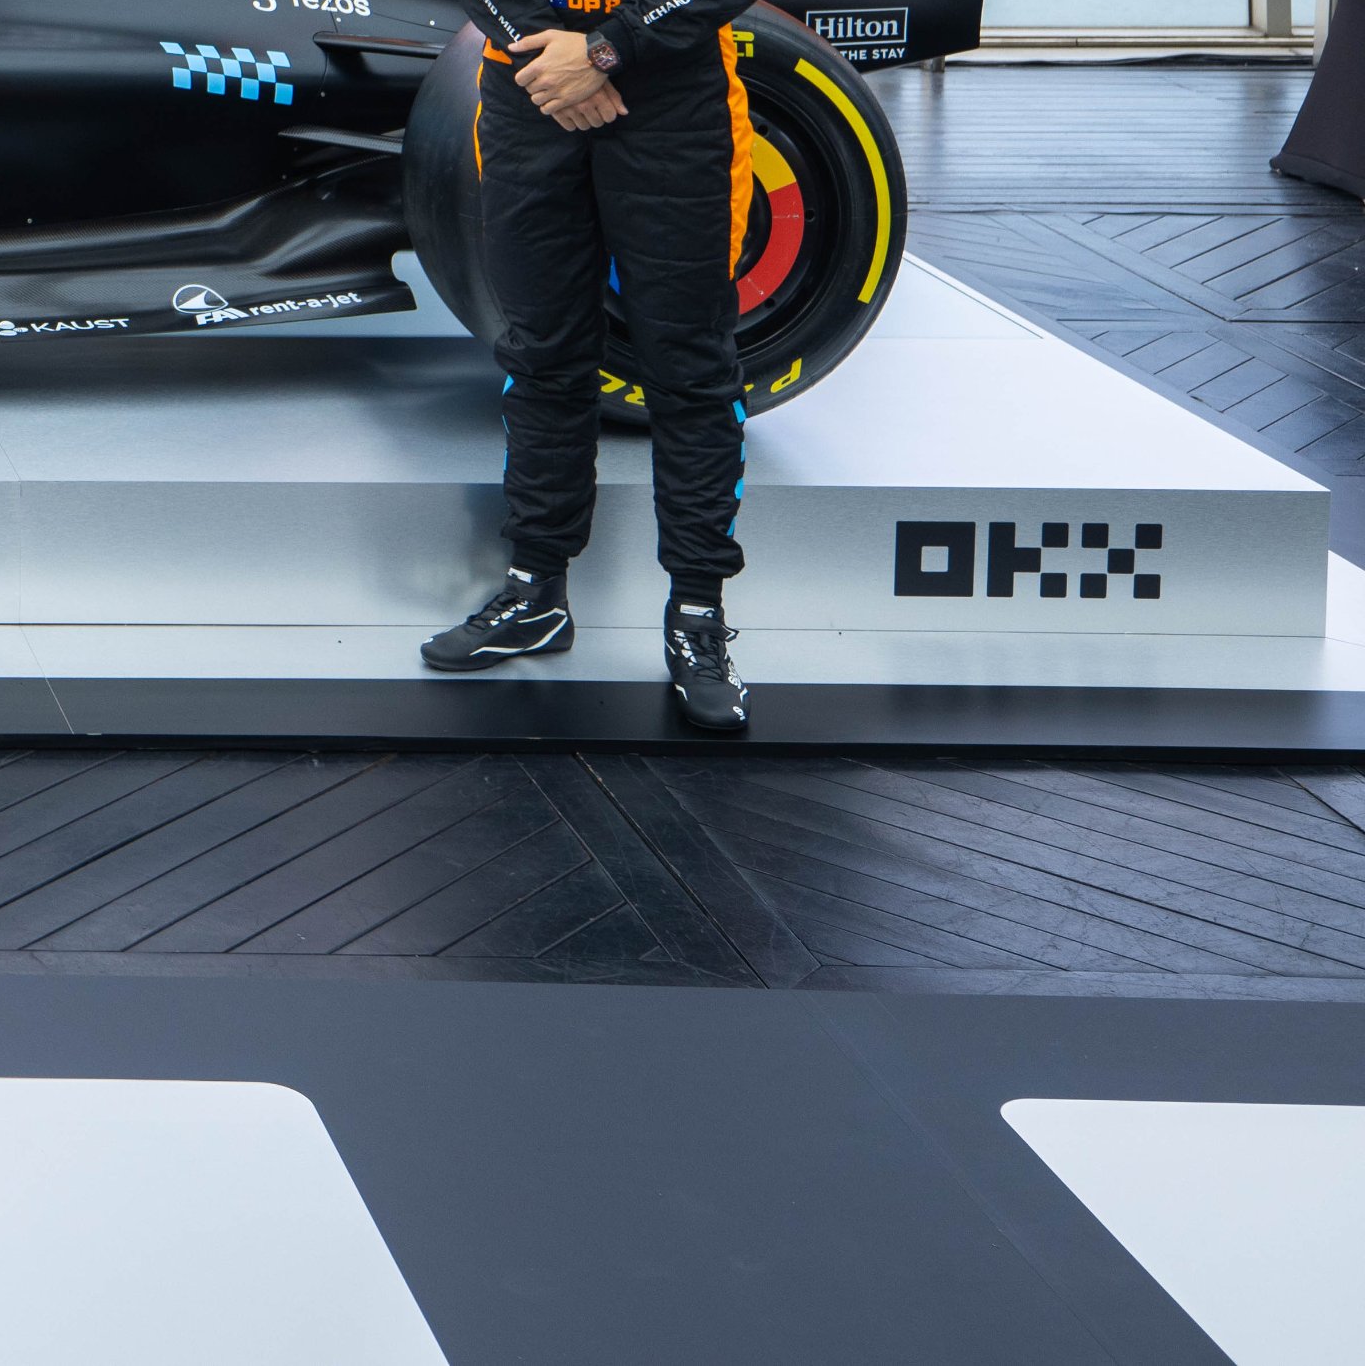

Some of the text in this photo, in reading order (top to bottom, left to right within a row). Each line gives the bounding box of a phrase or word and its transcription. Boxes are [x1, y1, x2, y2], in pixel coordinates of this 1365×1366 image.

[499, 15, 522, 44] MILL
[815, 16, 899, 39] Hilton
[841, 48, 906, 61] THE STAY
[249, 291, 363, 317] rent-a-jet
[30, 317, 130, 334] KAUST
[893, 521, 1163, 600] OKX
